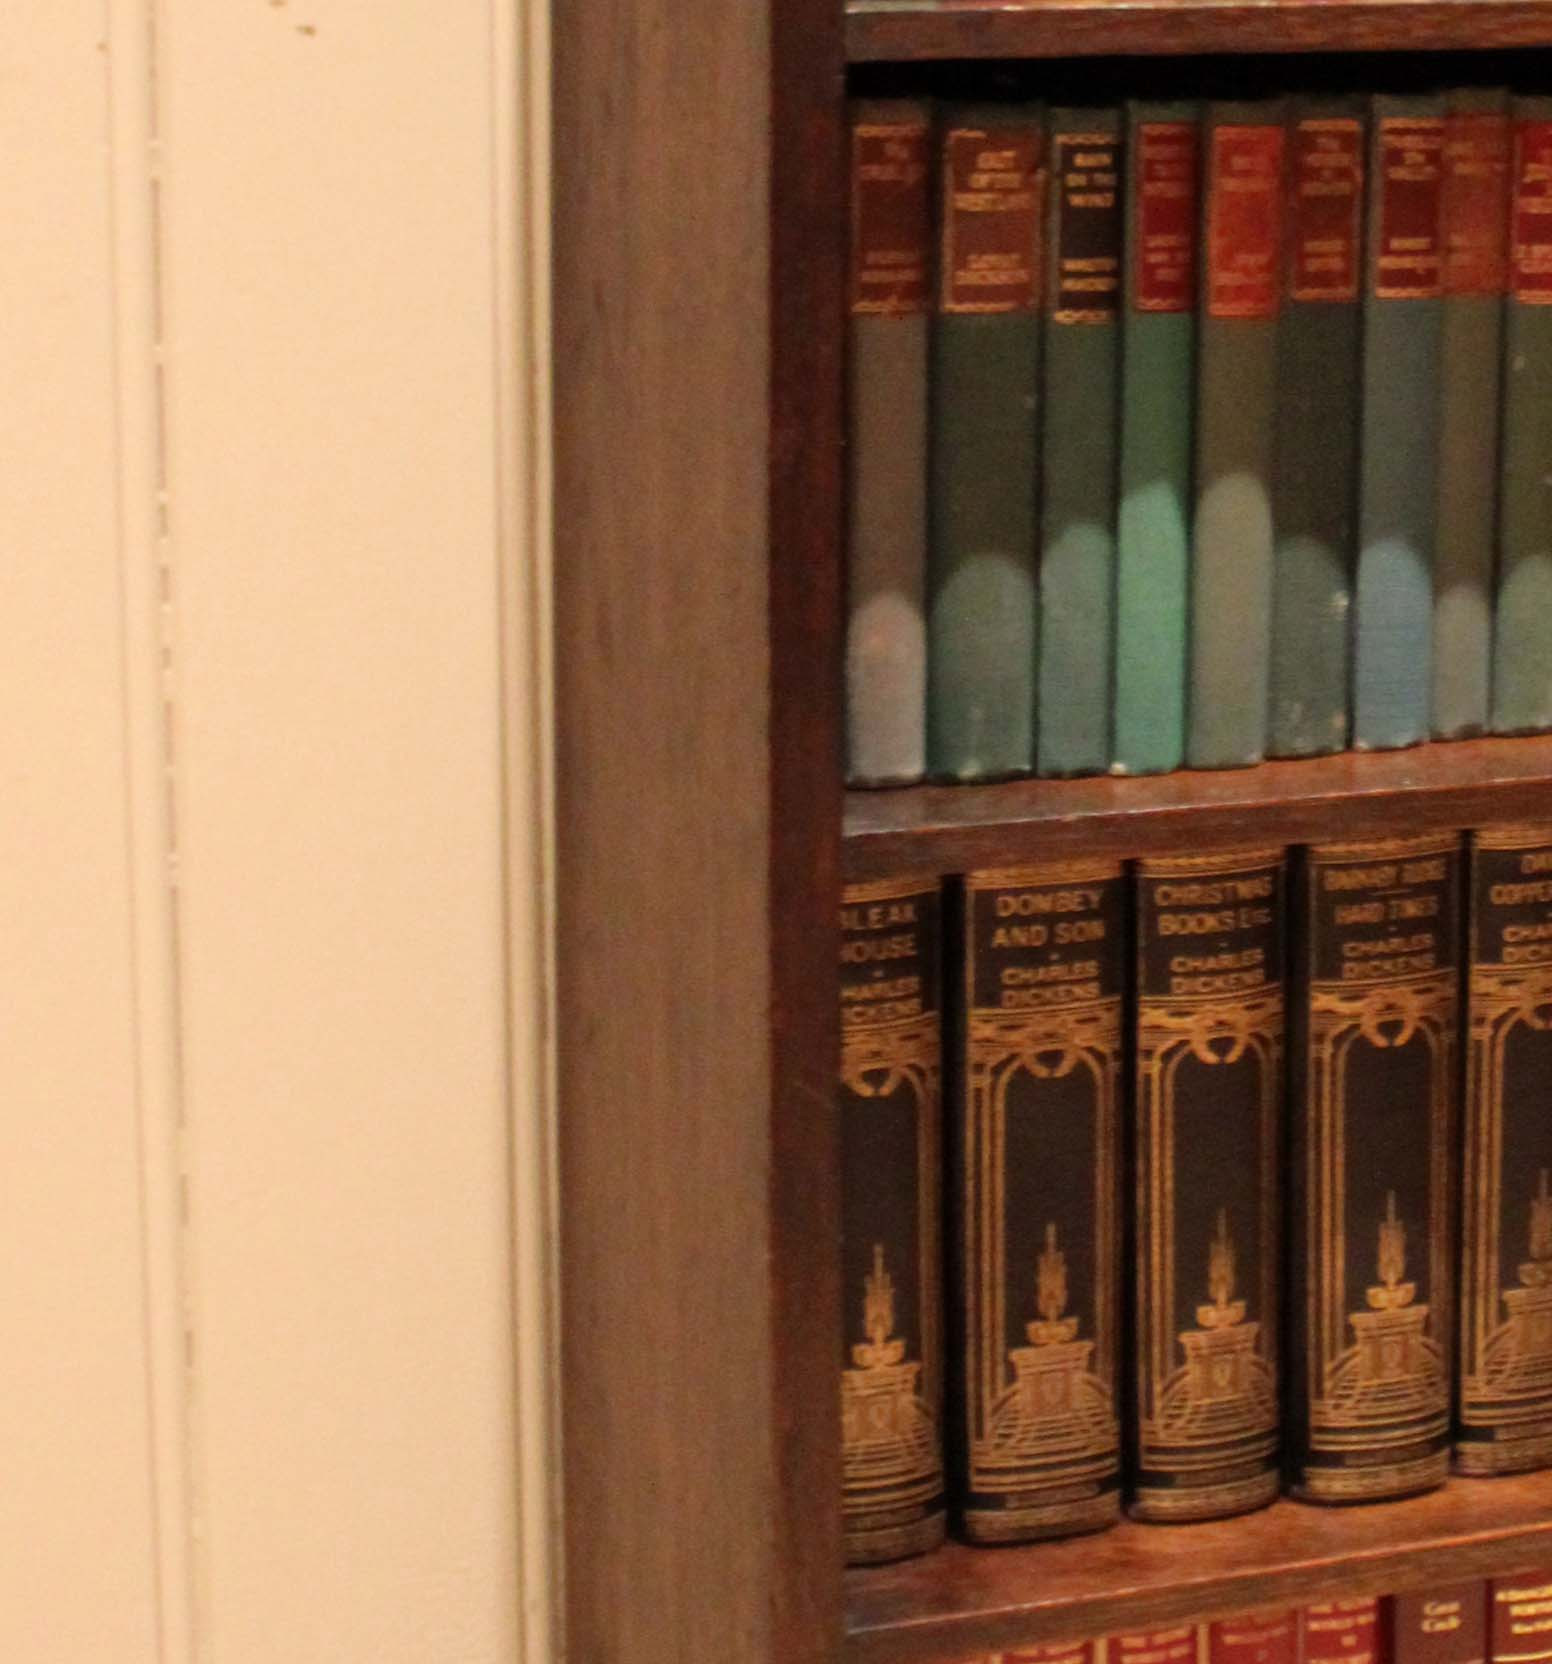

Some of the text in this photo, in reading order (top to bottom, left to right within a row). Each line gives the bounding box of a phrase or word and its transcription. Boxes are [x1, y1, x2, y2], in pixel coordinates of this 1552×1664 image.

[1324, 860, 1446, 891] BARNABY RUDGE
[997, 889, 1102, 917] DOMBEY
[1155, 876, 1273, 907] CHRISTMAS
[1158, 911, 1234, 936] BOOKS
[1335, 896, 1438, 925] HARD TIMES
[993, 919, 1104, 949] AND SON
[1343, 934, 1434, 957] CHARLES
[1002, 960, 1099, 987] CHARLES
[1170, 949, 1265, 974] CHARLES
[1343, 953, 1435, 979] DICKENS
[1002, 982, 1099, 1009] DICKENS
[1170, 969, 1265, 995] DICKENS
